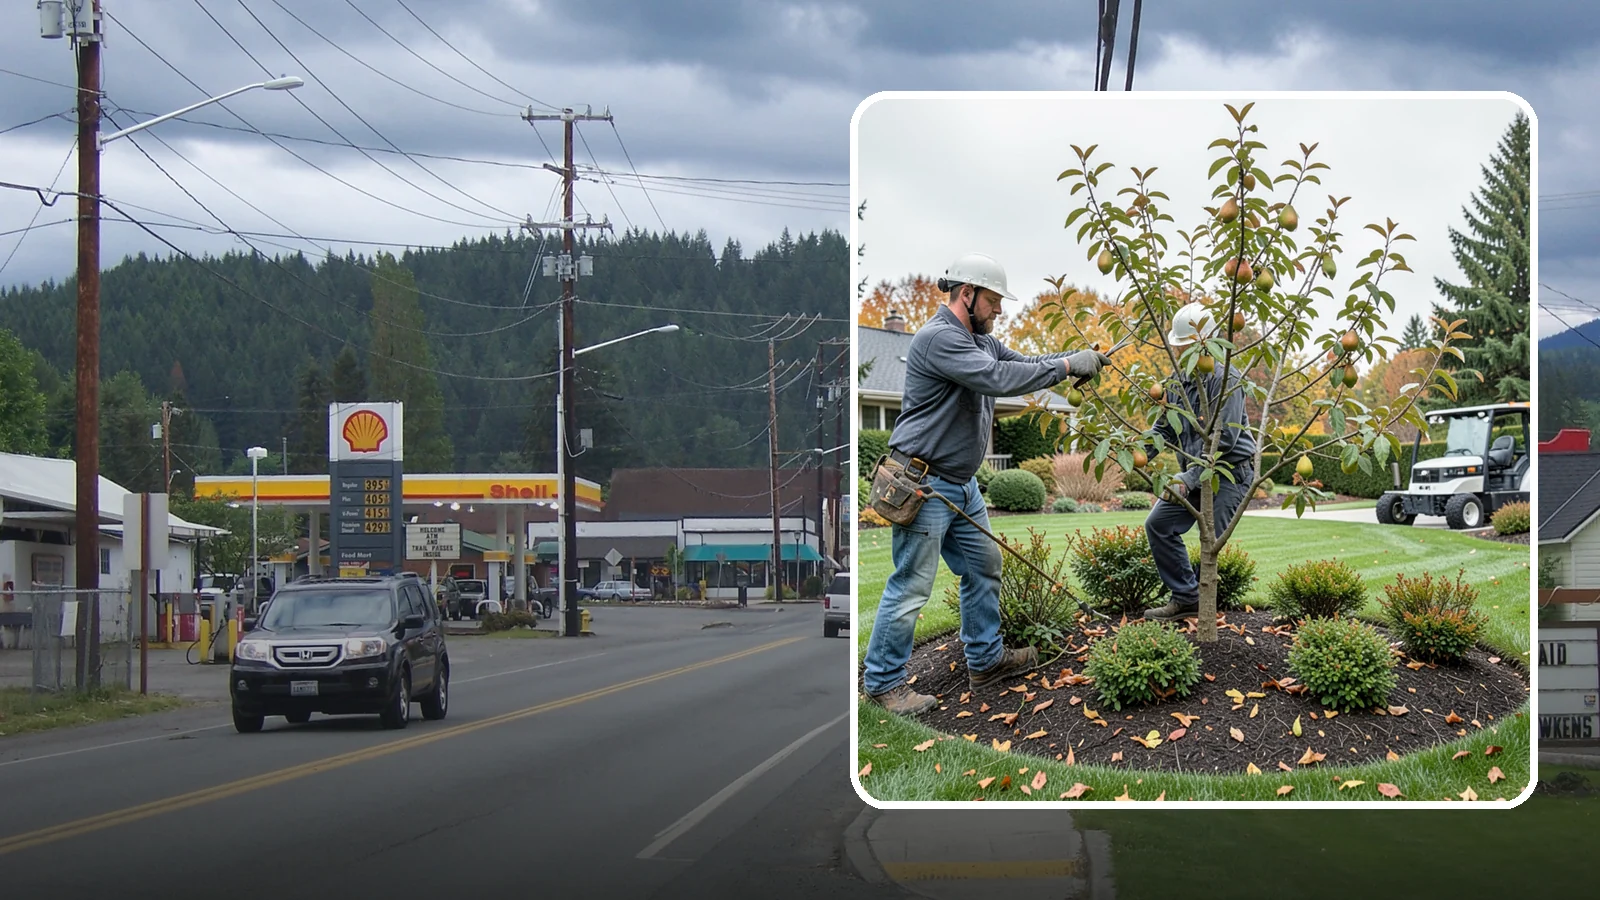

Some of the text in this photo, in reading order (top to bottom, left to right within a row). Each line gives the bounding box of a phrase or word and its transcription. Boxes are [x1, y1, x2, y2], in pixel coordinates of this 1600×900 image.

[366, 480, 383, 490] 395
[489, 484, 548, 499] Shell
[365, 494, 384, 504] 405
[365, 508, 383, 518] 415
[366, 522, 384, 532] 429
[1538, 643, 1566, 665] AID
